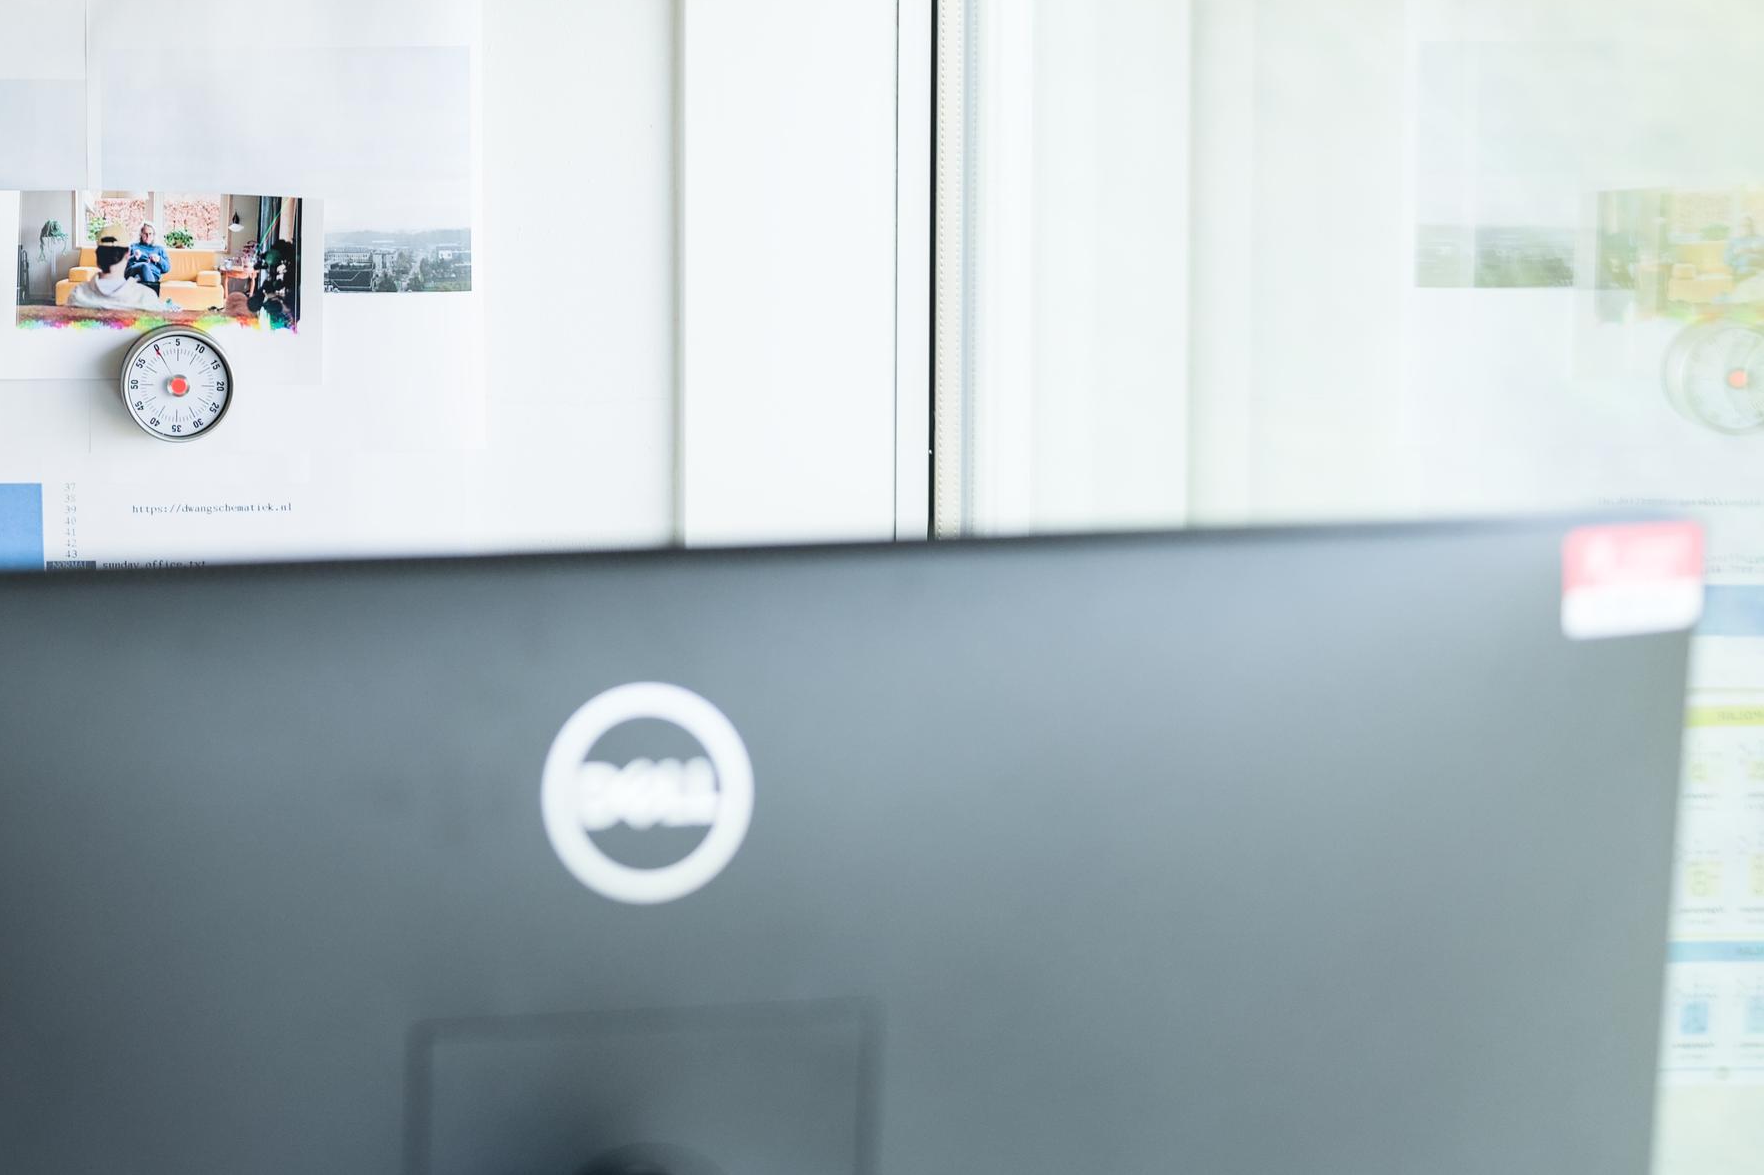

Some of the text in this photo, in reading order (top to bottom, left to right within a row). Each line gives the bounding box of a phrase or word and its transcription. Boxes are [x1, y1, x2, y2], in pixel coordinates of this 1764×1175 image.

[175, 338, 181, 346] 5
[195, 343, 205, 354] 10
[136, 357, 146, 369] 55
[210, 359, 221, 370] 15
[130, 379, 139, 390] 50
[216, 381, 225, 392] 20
[134, 400, 144, 411] 45
[209, 402, 220, 414] 25
[149, 417, 161, 427] 40
[192, 418, 204, 428] 30
[171, 424, 182, 432] 35
